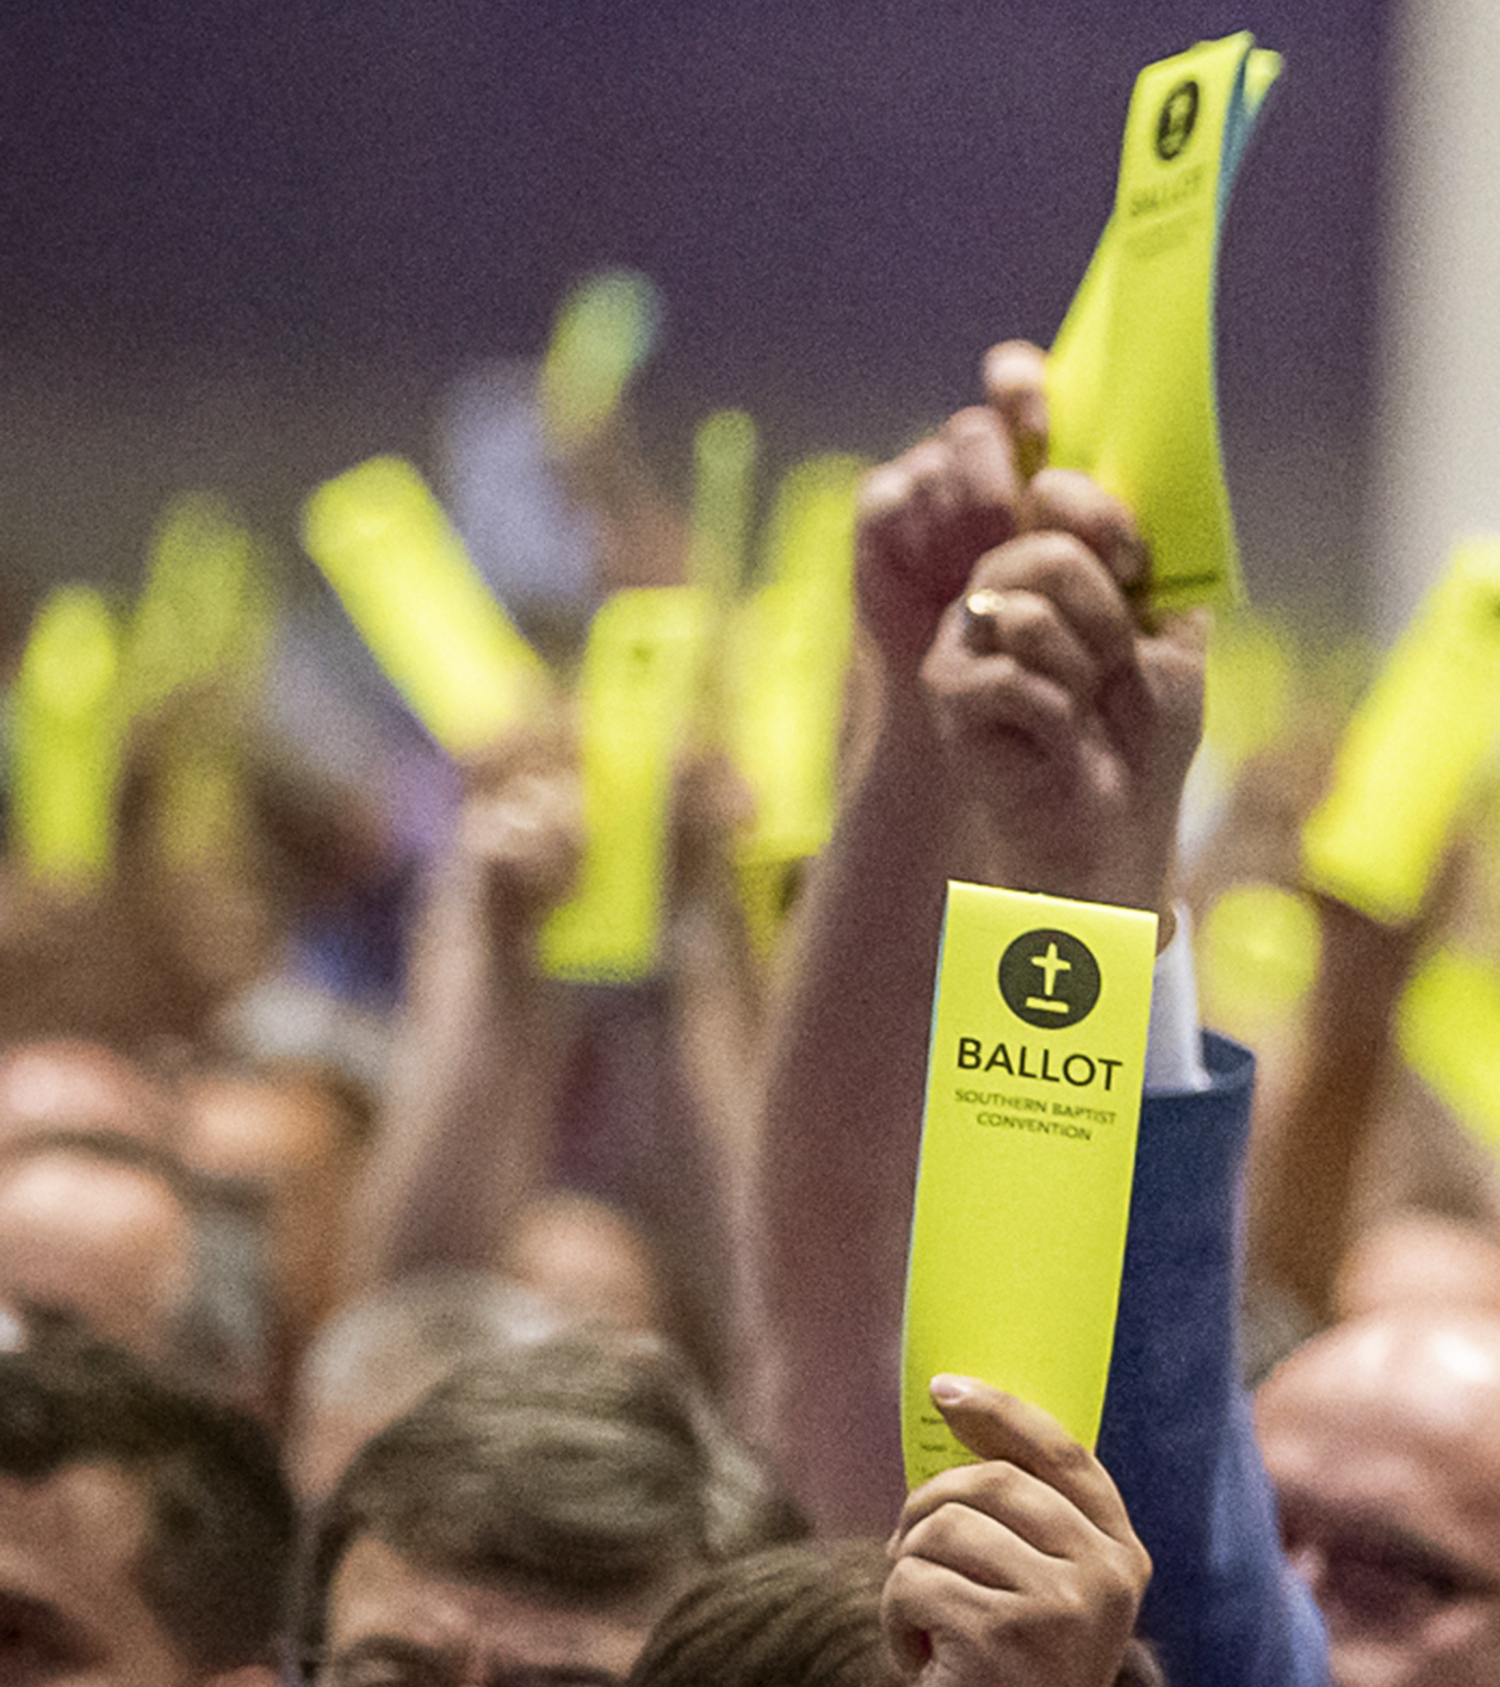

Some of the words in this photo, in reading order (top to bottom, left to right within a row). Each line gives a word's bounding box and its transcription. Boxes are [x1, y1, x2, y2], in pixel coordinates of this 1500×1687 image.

[957, 1037, 1123, 1091] BALLOT
[954, 1088, 1047, 1113] SOUTHERN
[1052, 1103, 1117, 1125] BAPTIST
[976, 1111, 1091, 1141] CONVENTION
